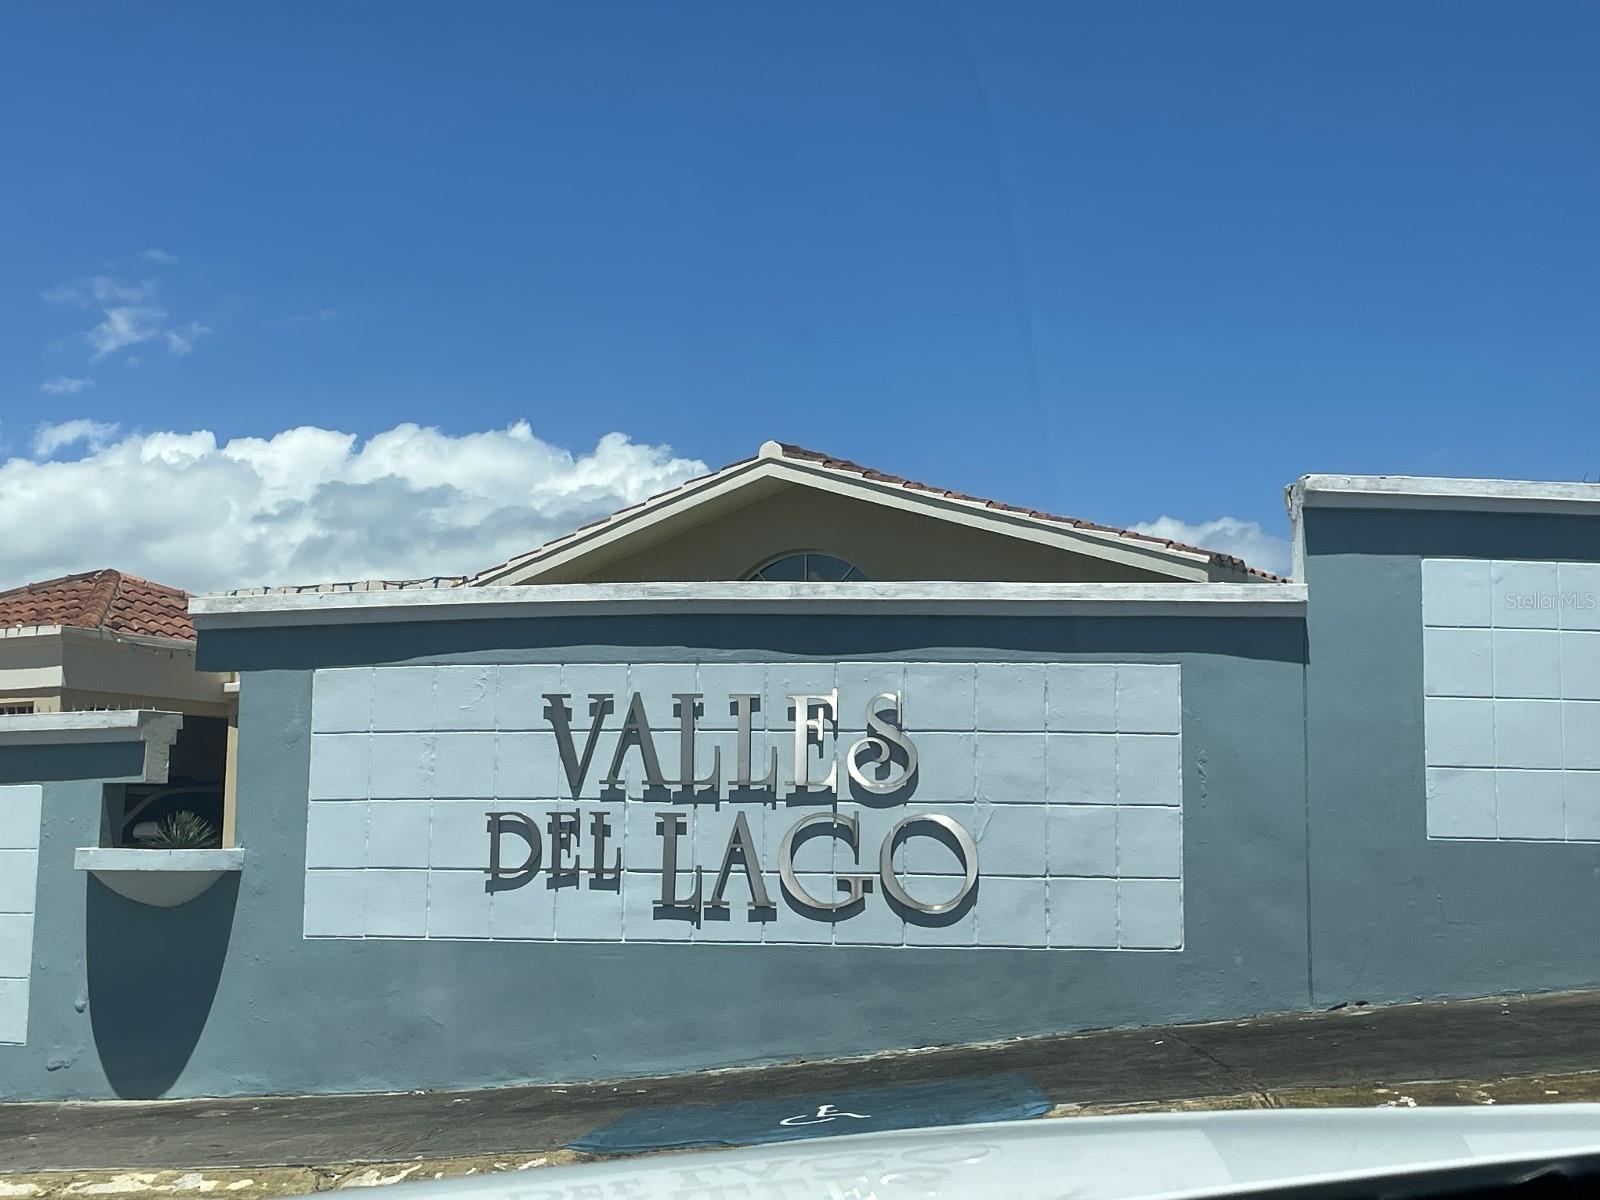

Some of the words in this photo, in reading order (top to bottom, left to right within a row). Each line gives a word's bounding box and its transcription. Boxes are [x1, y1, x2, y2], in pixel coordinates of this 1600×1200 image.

[541, 688, 919, 798] VALLES
[484, 808, 622, 884] DEL
[653, 809, 980, 918] LAGO
